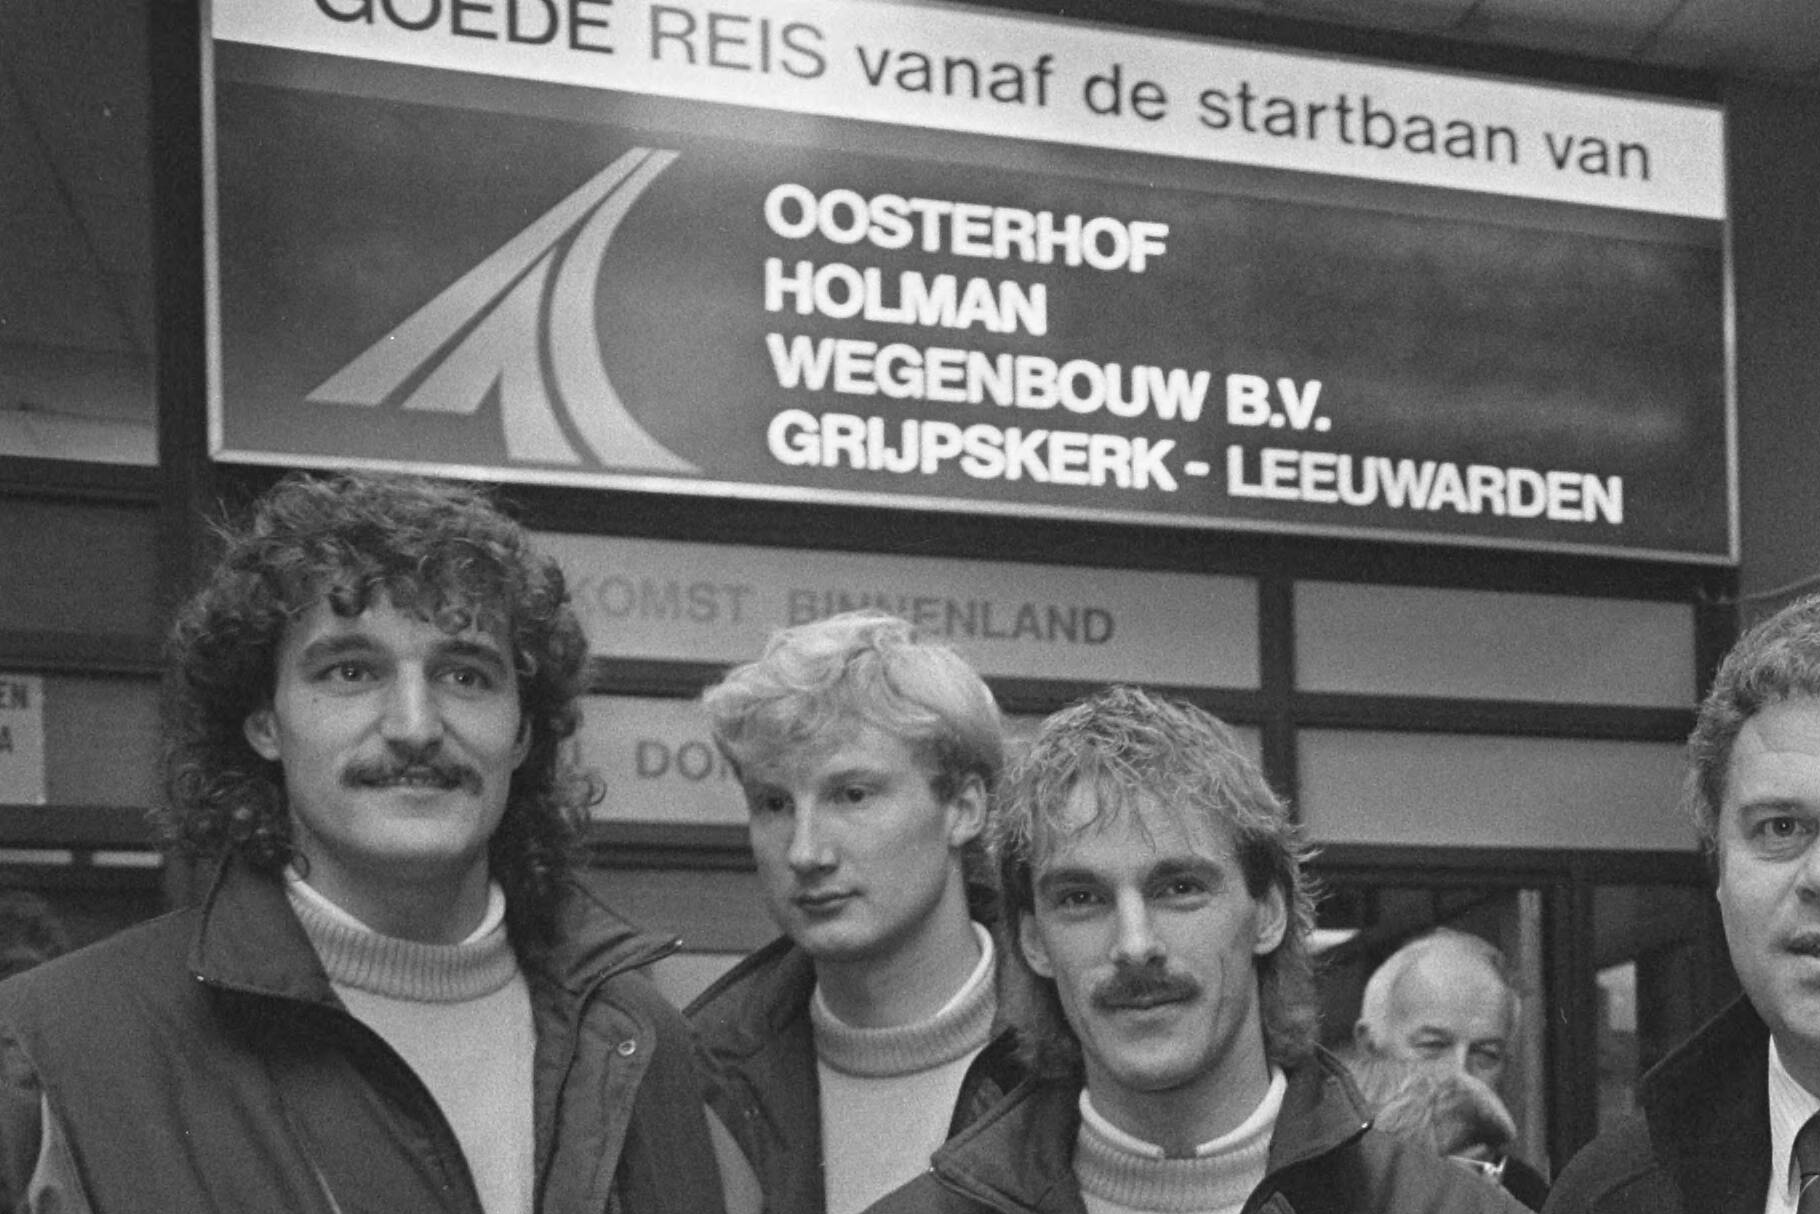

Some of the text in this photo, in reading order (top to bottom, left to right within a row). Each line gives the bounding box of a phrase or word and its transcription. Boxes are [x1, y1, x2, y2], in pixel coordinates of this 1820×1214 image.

[650, 4, 827, 79] REIS
[856, 44, 1054, 107] vanaf
[1083, 62, 1169, 122] de
[1199, 81, 1519, 165] startbaan
[1543, 131, 1653, 181] van
[764, 183, 1169, 272] OOSTERHOF
[764, 257, 1047, 335] HOLMAN
[765, 333, 1332, 431] WEGENBOUW B.V.
[1227, 446, 1623, 523] LEEUWARDEN
